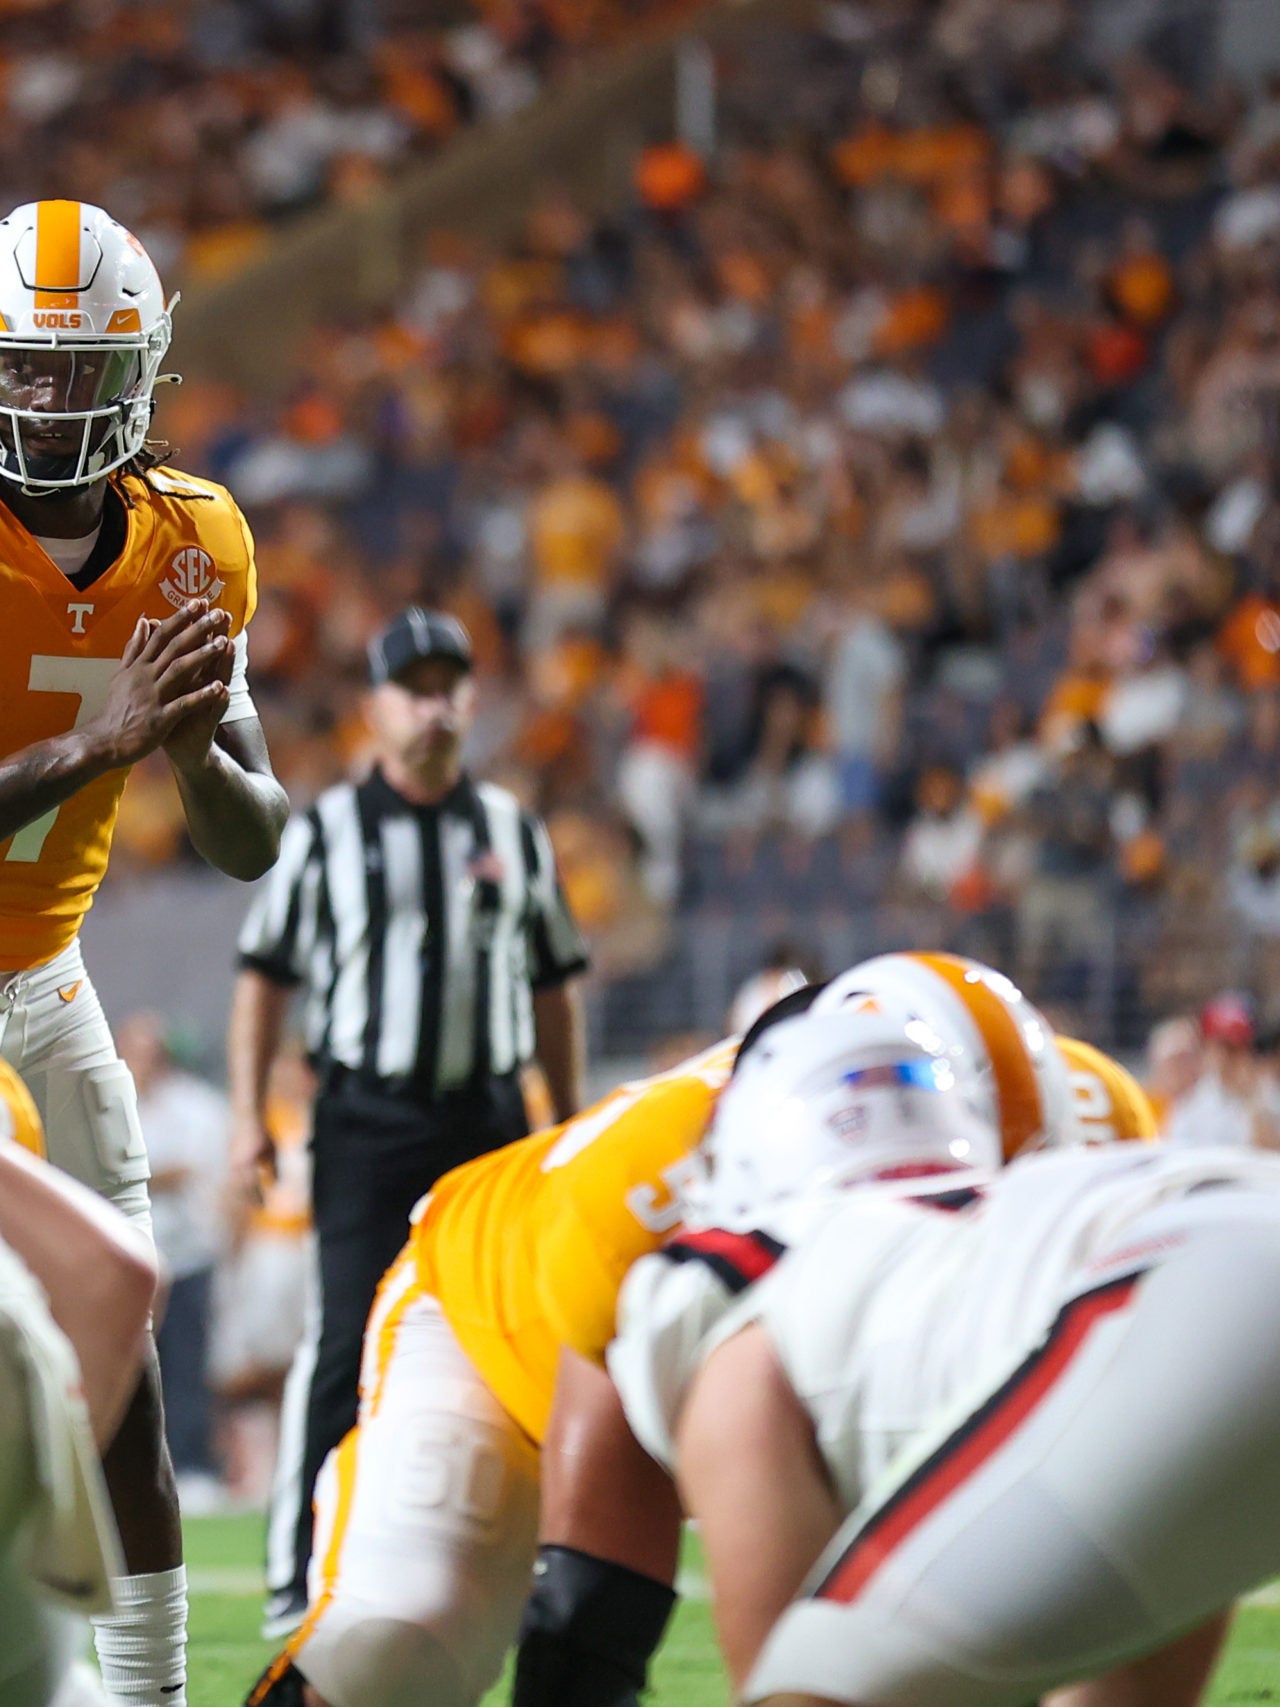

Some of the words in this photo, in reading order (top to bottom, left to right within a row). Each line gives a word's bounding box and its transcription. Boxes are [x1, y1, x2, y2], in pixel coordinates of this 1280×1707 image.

[33, 312, 82, 329] VOLS
[171, 547, 212, 595] SEC
[67, 603, 95, 634] T
[5, 654, 122, 863] 7
